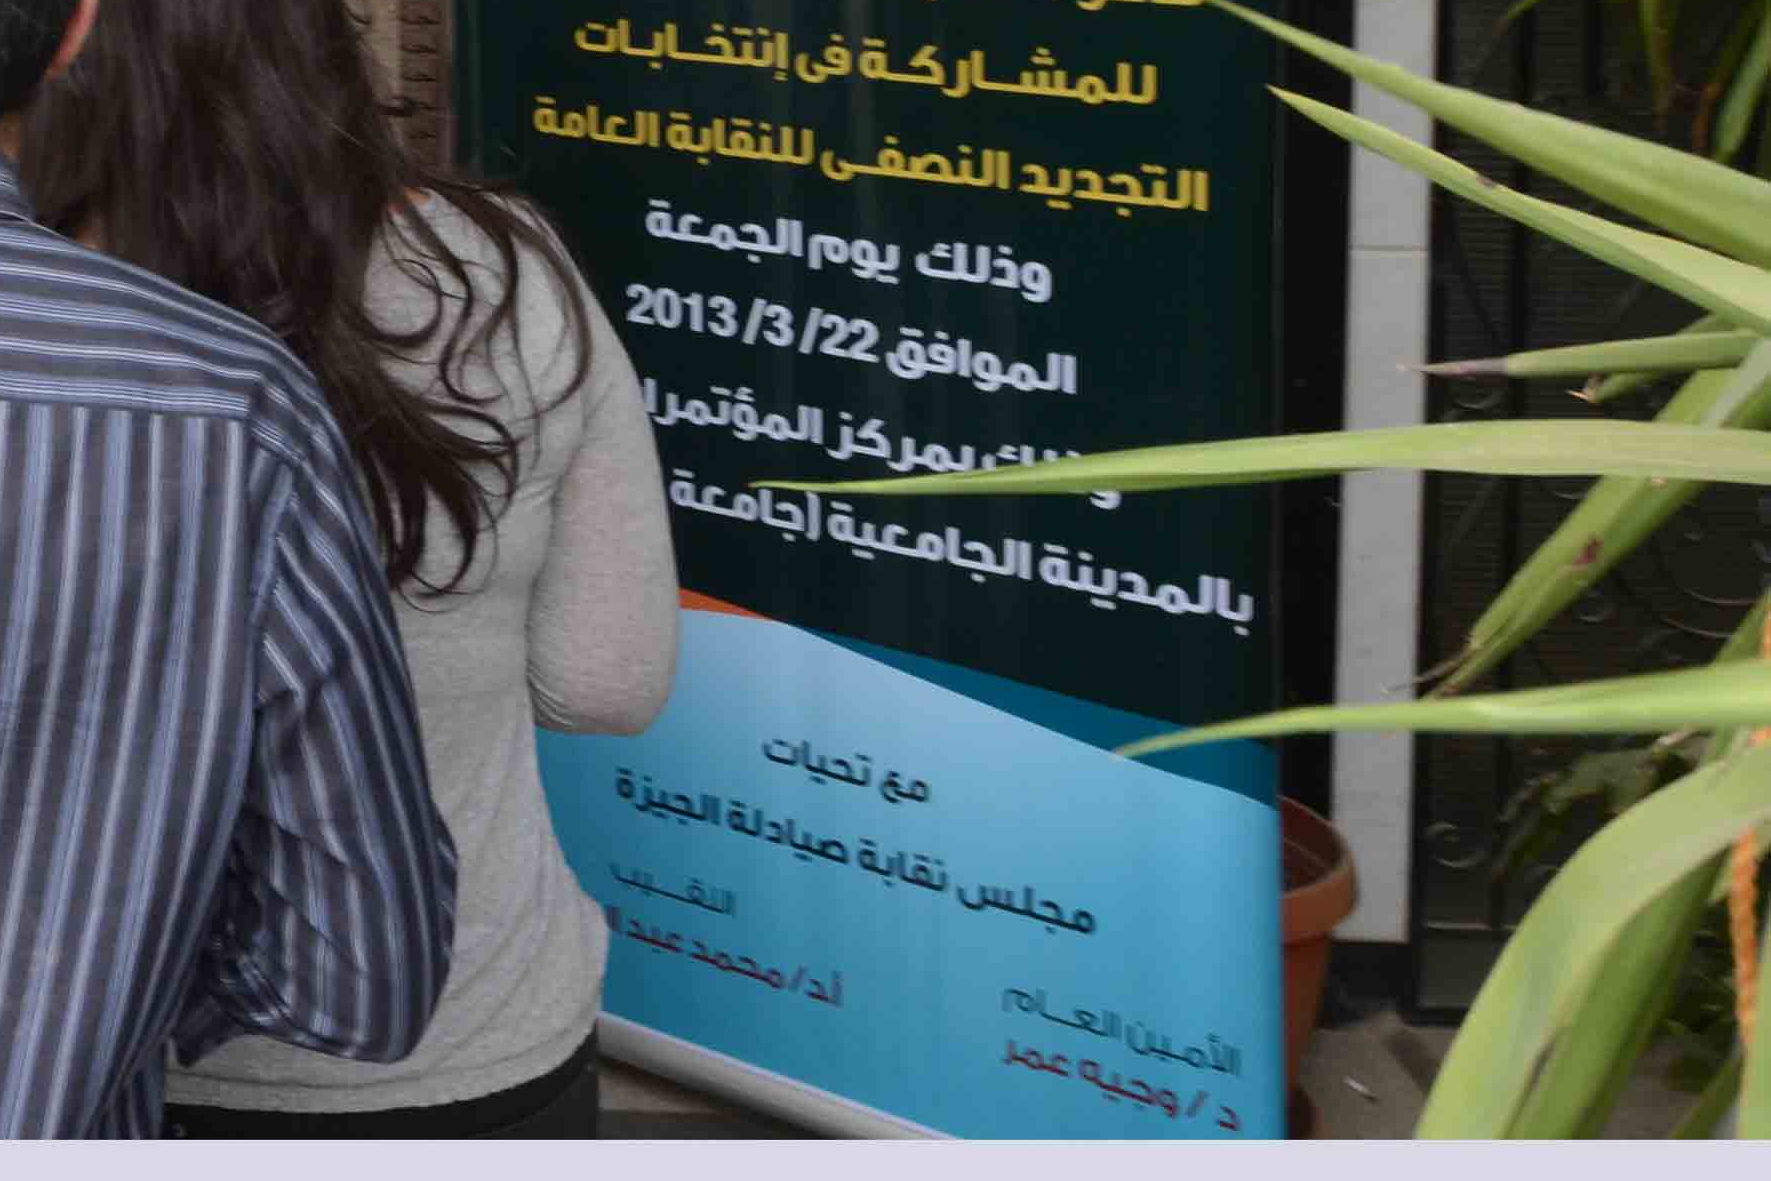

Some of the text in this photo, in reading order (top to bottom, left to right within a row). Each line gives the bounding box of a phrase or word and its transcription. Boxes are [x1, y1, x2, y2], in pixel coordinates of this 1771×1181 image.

[575, 20, 788, 81] إنتخابات
[858, 38, 1157, 104] للمشاركة
[534, 97, 660, 147] العامة
[666, 111, 814, 165] للنقابة
[1020, 163, 1209, 217] التجديد
[646, 199, 1053, 303] وذلك يوم الجمعة
[885, 327, 1077, 394] الموافق
[643, 378, 975, 473] بمركز المؤتمرا
[827, 501, 1031, 582] الجامعية
[1039, 542, 1254, 635] بالمدينة
[762, 738, 929, 803] مع تحيات
[616, 768, 1096, 934] مجلس نقابة صيادلة الجيزة
[1000, 987, 1242, 1077] الأمين العام
[1000, 1039, 1071, 1077] عمر
